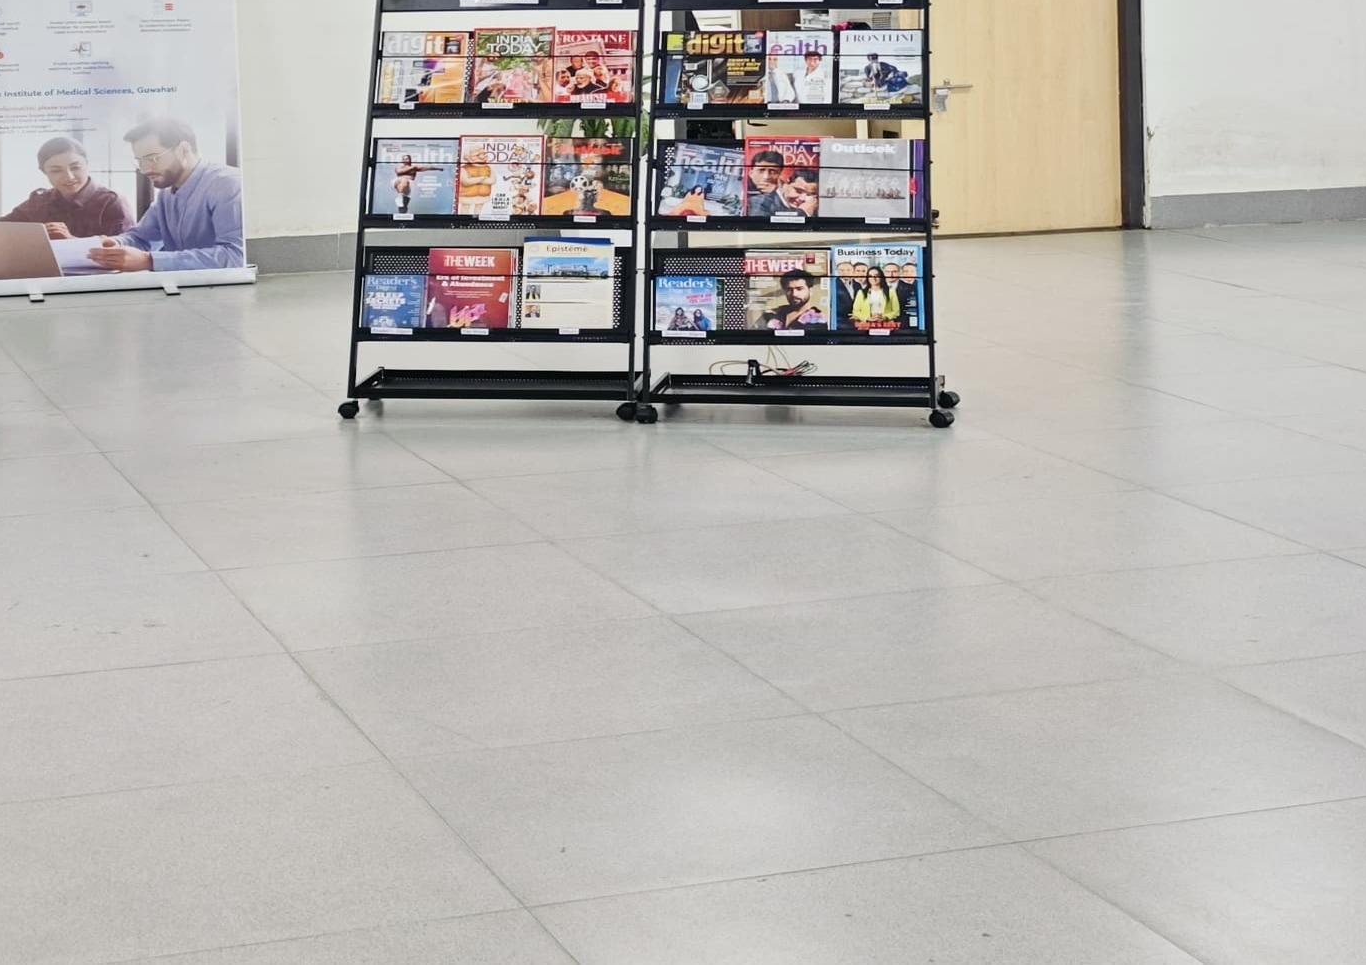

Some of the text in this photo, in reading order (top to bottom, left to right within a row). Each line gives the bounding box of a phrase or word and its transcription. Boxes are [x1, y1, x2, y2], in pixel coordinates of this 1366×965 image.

[386, 33, 444, 56] digit
[496, 35, 535, 45] INDIA
[686, 33, 745, 55] digit
[487, 43, 543, 55] TODAY
[770, 39, 828, 55] ealth
[4, 90, 42, 98] Institute
[44, 89, 55, 97] of
[57, 88, 91, 97] Medical
[137, 85, 178, 94] Guwahati
[483, 143, 518, 152] INDIA
[768, 145, 807, 154] INDIA
[831, 143, 898, 154] Outlook
[783, 153, 817, 166] DAY
[837, 248, 915, 256] Business Today
